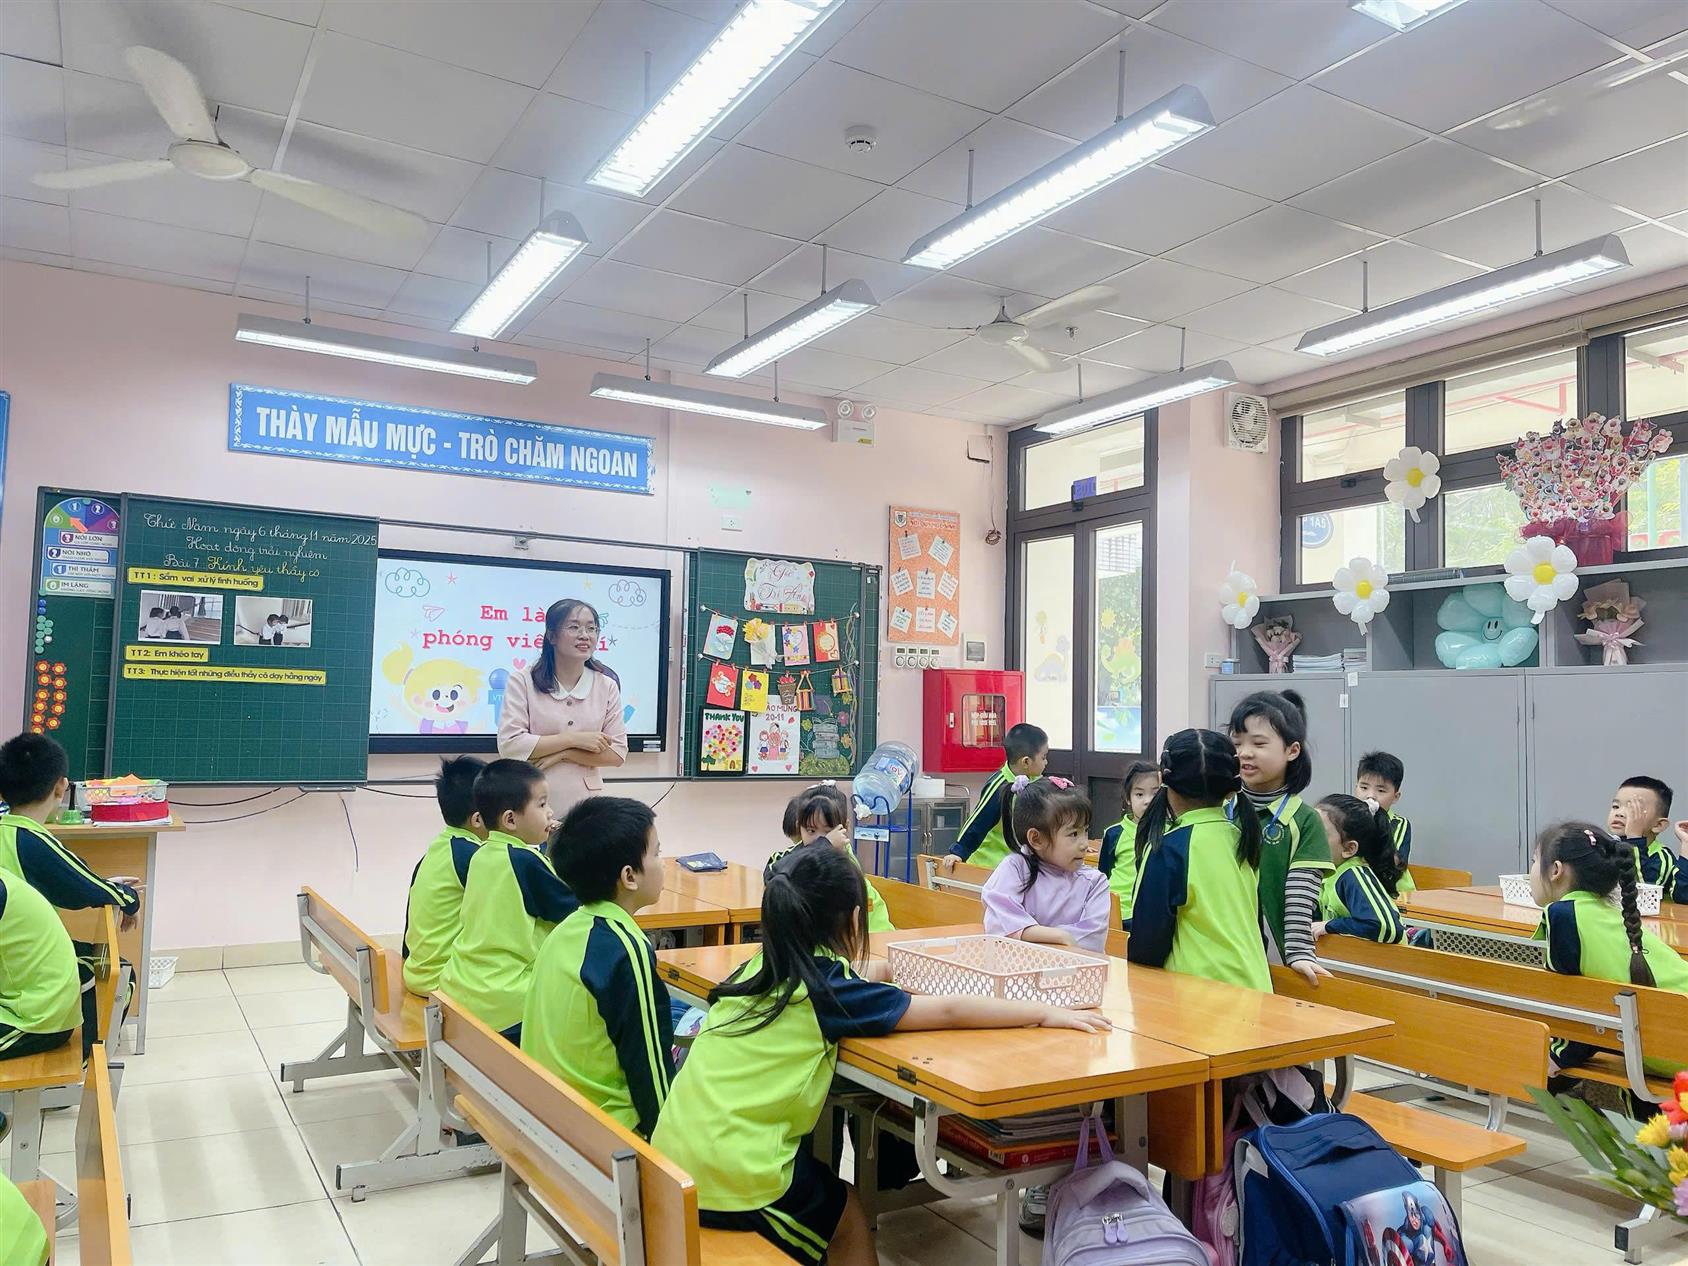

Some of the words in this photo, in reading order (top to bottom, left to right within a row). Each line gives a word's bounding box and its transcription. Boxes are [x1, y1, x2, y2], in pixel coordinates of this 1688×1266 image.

[325, 407, 379, 449] MẪU
[386, 422, 436, 459] MỰC
[458, 428, 499, 462] TRÒ
[504, 435, 564, 470] CHĂM
[570, 445, 638, 478] NGOAN
[258, 526, 266, 537] 6
[309, 529, 319, 541] 11
[350, 533, 378, 547] 2025
[182, 574, 195, 582] vai
[480, 604, 509, 620] Em
[522, 606, 545, 623] là
[422, 629, 493, 651] phóng
[507, 633, 545, 649] viê
[191, 651, 204, 660] tay
